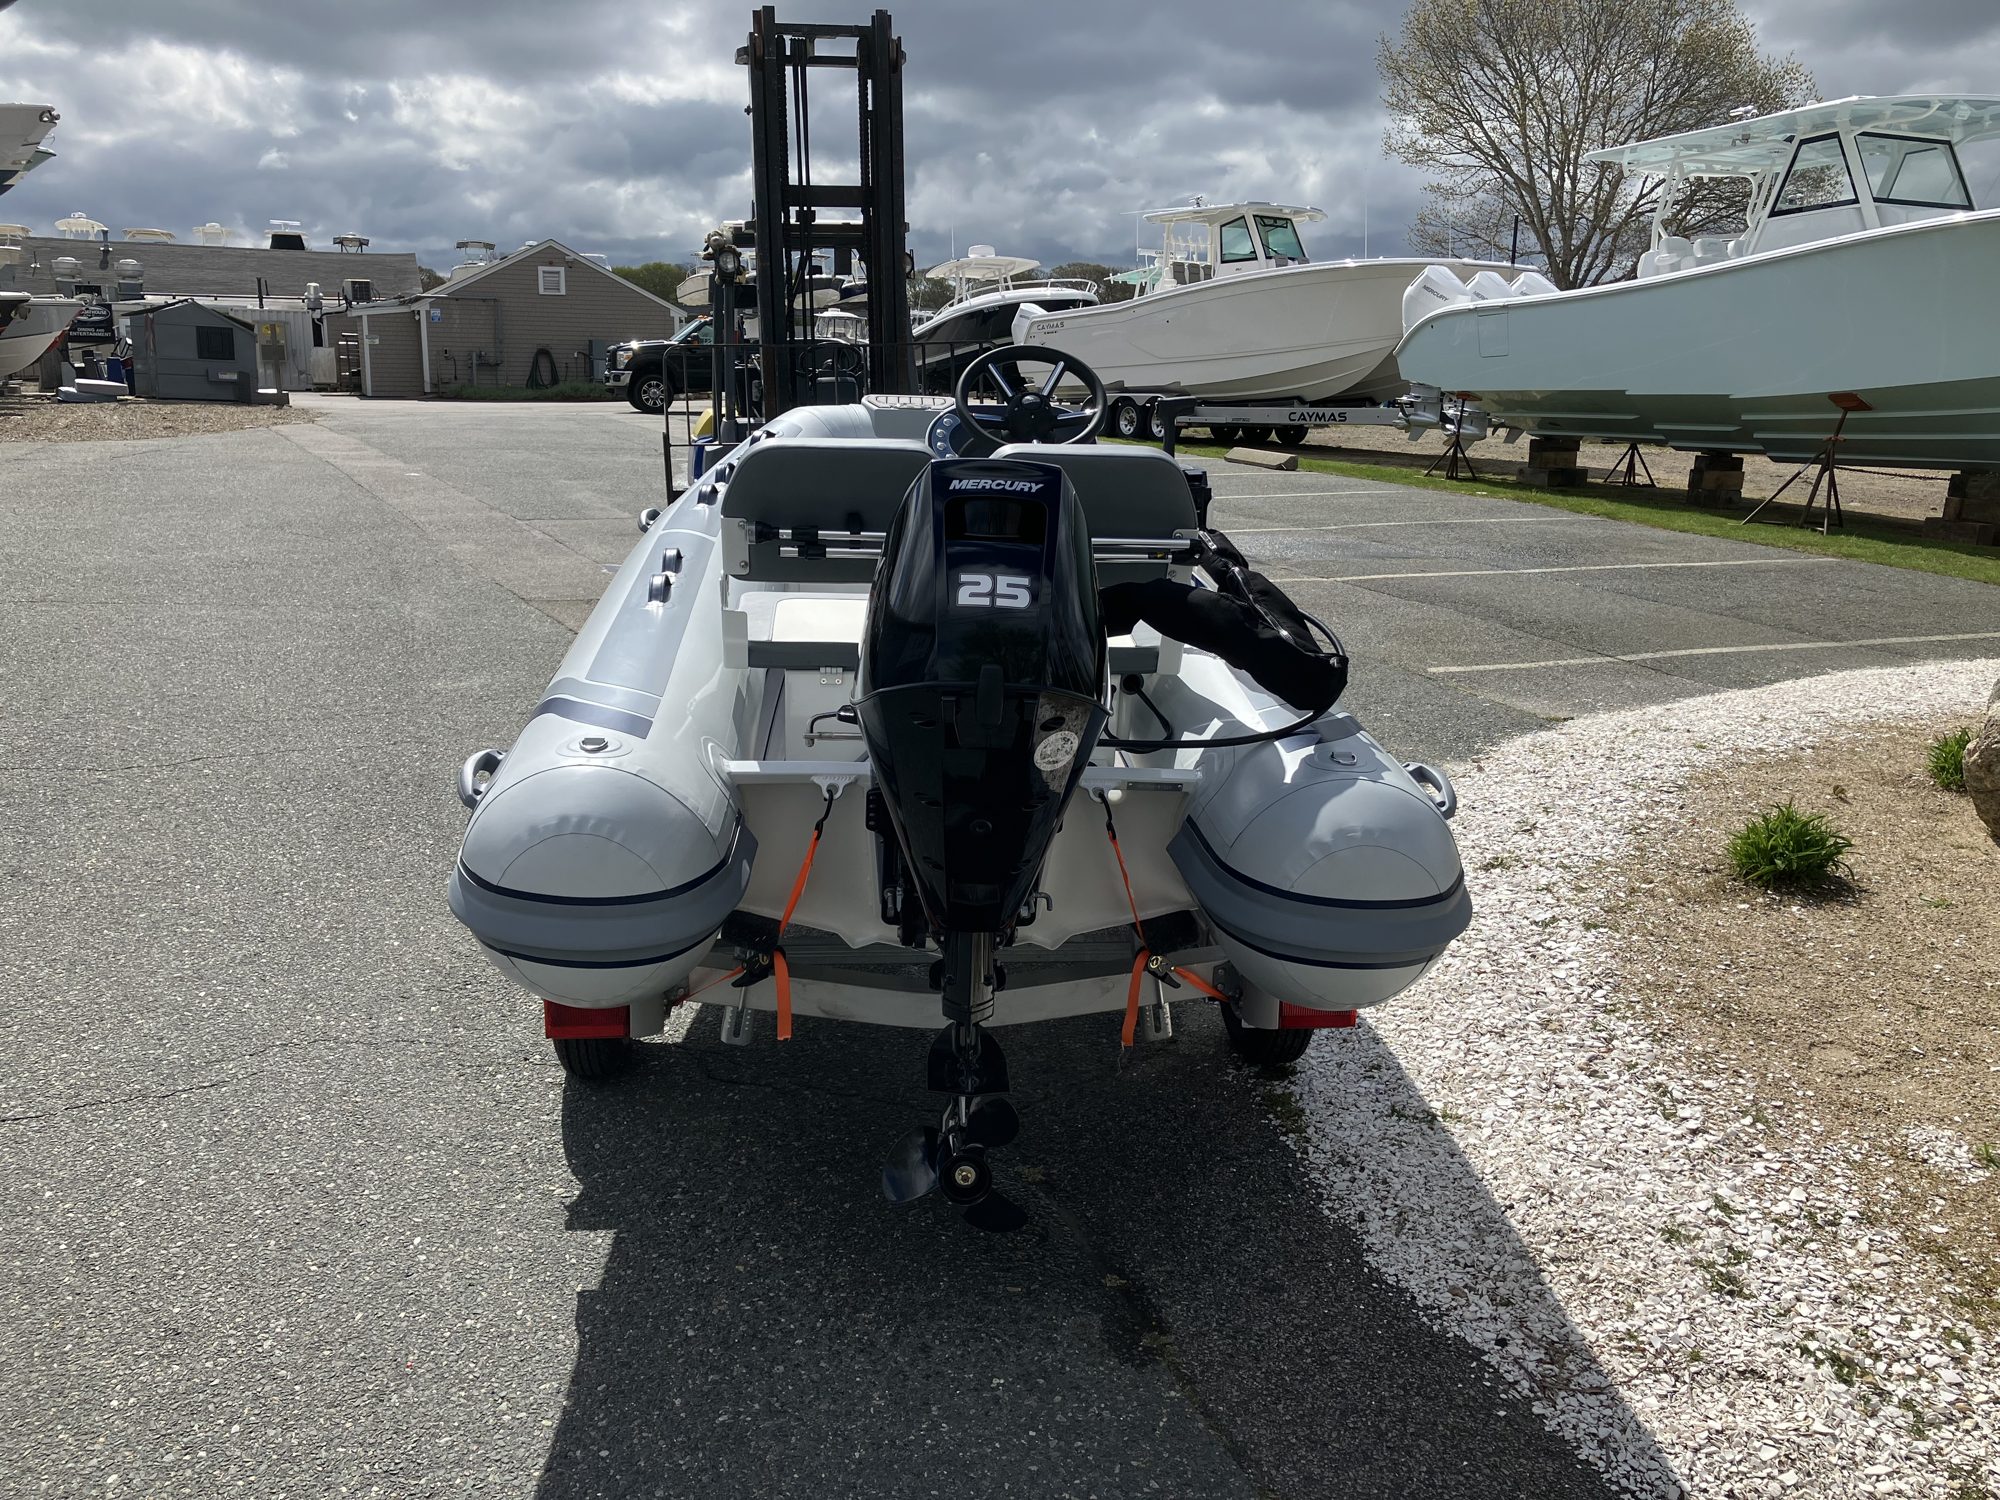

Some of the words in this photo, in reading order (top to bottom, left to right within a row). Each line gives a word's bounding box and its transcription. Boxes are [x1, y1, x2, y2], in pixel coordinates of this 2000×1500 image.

[1422, 284, 1449, 302] MERCURY
[1036, 321, 1065, 331] CAYMAS
[1288, 411, 1348, 422] CAYMAS
[948, 479, 1044, 493] MERCURY
[957, 573, 1032, 609] 25
